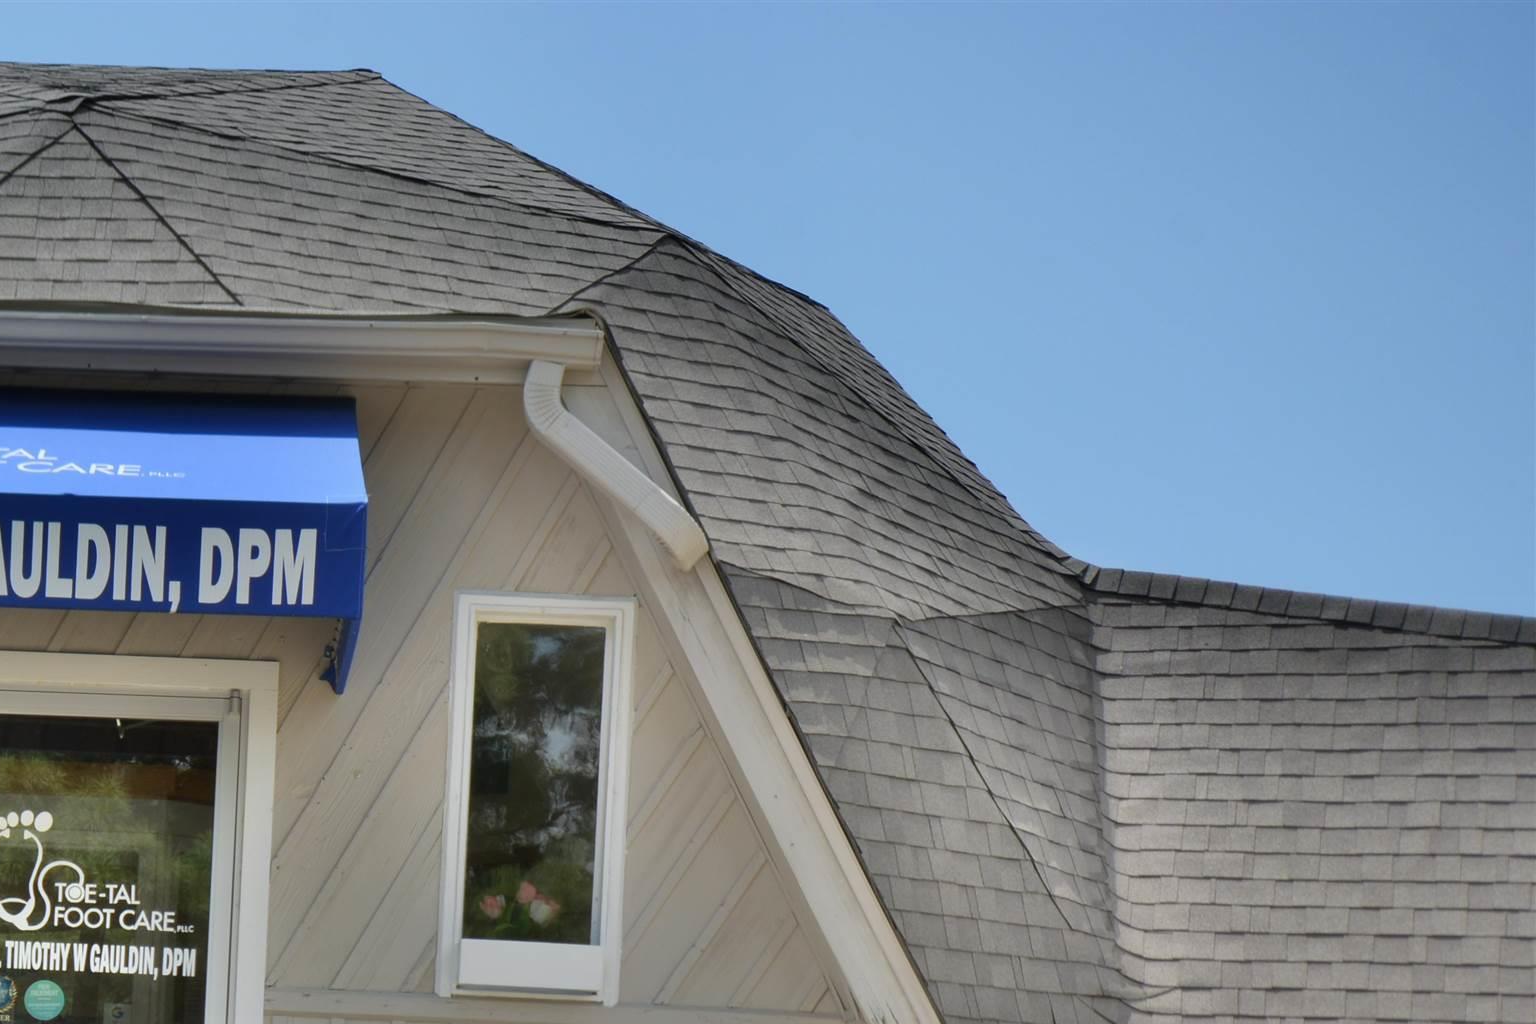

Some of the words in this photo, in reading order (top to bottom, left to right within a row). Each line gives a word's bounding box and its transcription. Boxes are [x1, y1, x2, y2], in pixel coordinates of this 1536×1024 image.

[198, 527, 318, 606] DPM
[54, 882, 141, 905] TOE-TAL
[53, 905, 116, 930] FOOT
[177, 924, 195, 934] PLLC
[4, 939, 72, 972] TIMOTHY
[72, 942, 89, 972] W
[89, 943, 159, 981] GAULDIN,
[161, 946, 197, 977] DPM
